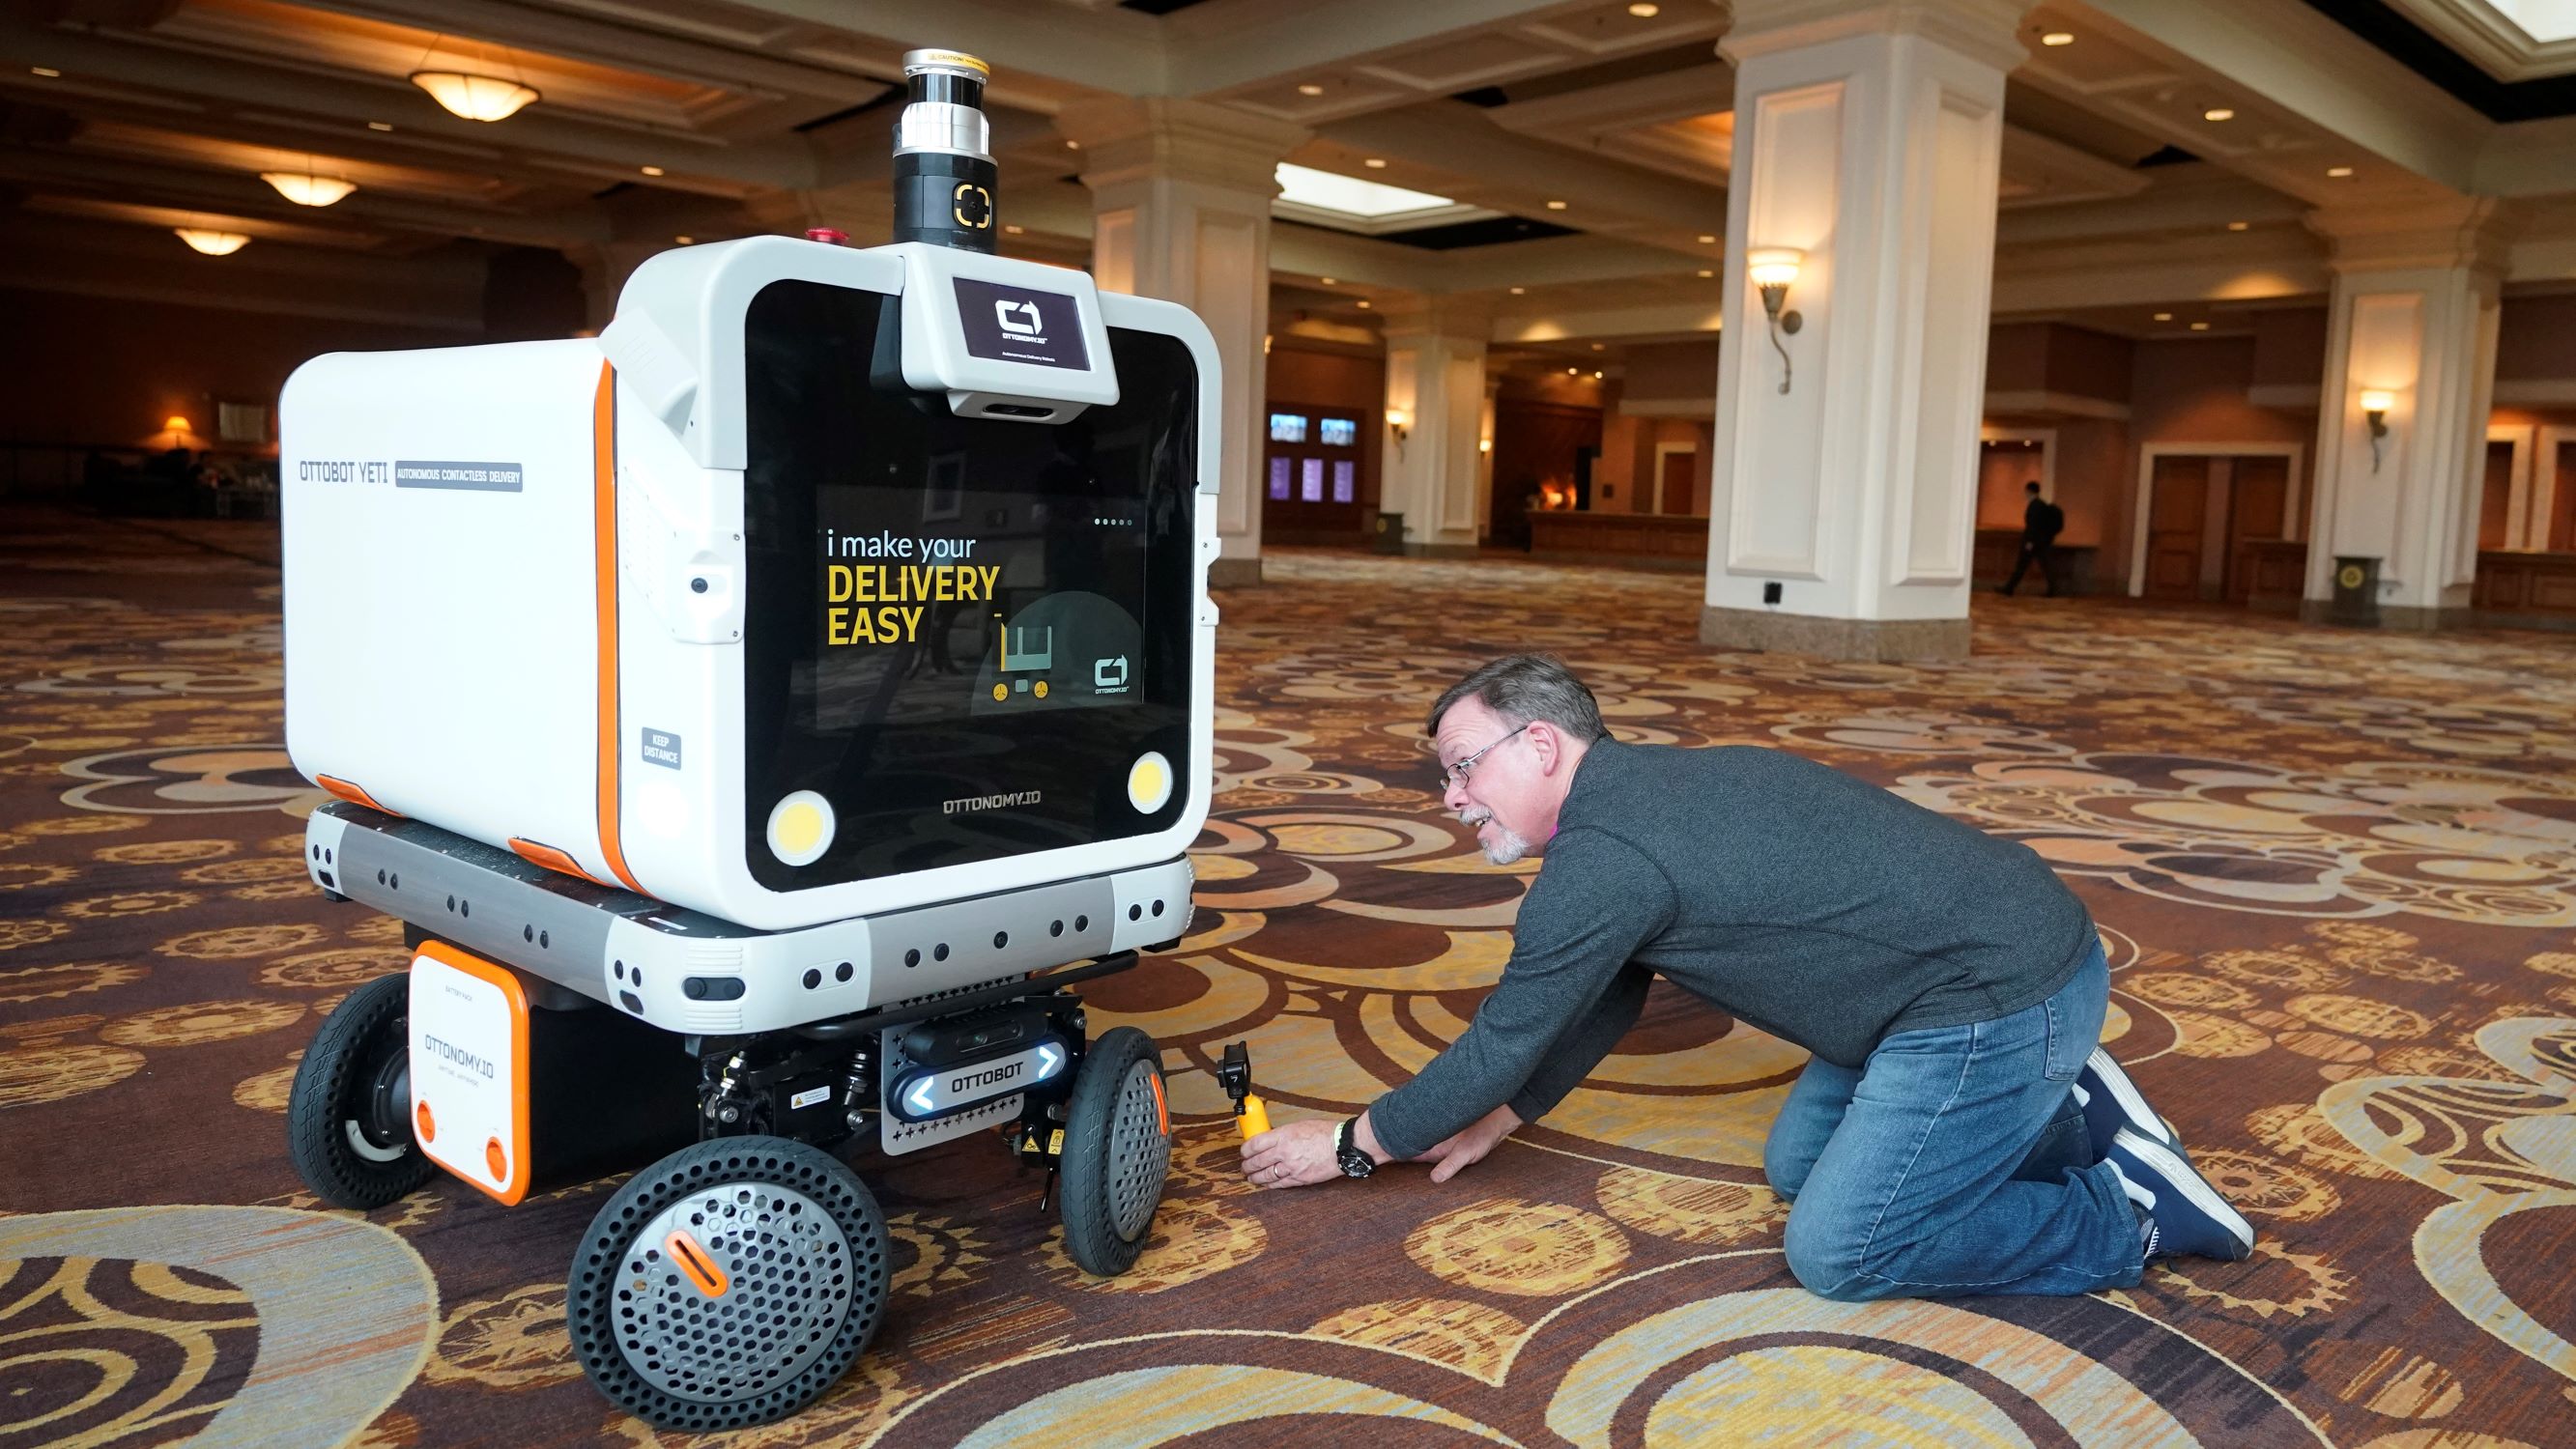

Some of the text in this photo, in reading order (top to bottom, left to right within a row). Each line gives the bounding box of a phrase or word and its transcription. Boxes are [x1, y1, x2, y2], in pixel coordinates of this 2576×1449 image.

[300, 460, 388, 484] OTTOBOT YETI
[396, 468, 521, 484] AUTONOMOUS CONTACTLESS DELIVERY
[827, 528, 977, 563] i make your
[828, 564, 1001, 603] DELIVERY
[828, 606, 925, 645] EASY
[644, 745, 678, 763] DISTANCE
[652, 733, 670, 747] KEEP
[943, 790, 1042, 814] OTTONOMY.IO
[425, 1034, 494, 1079] OTTONOMY.IO
[952, 1061, 1024, 1094] OTTOBOT
